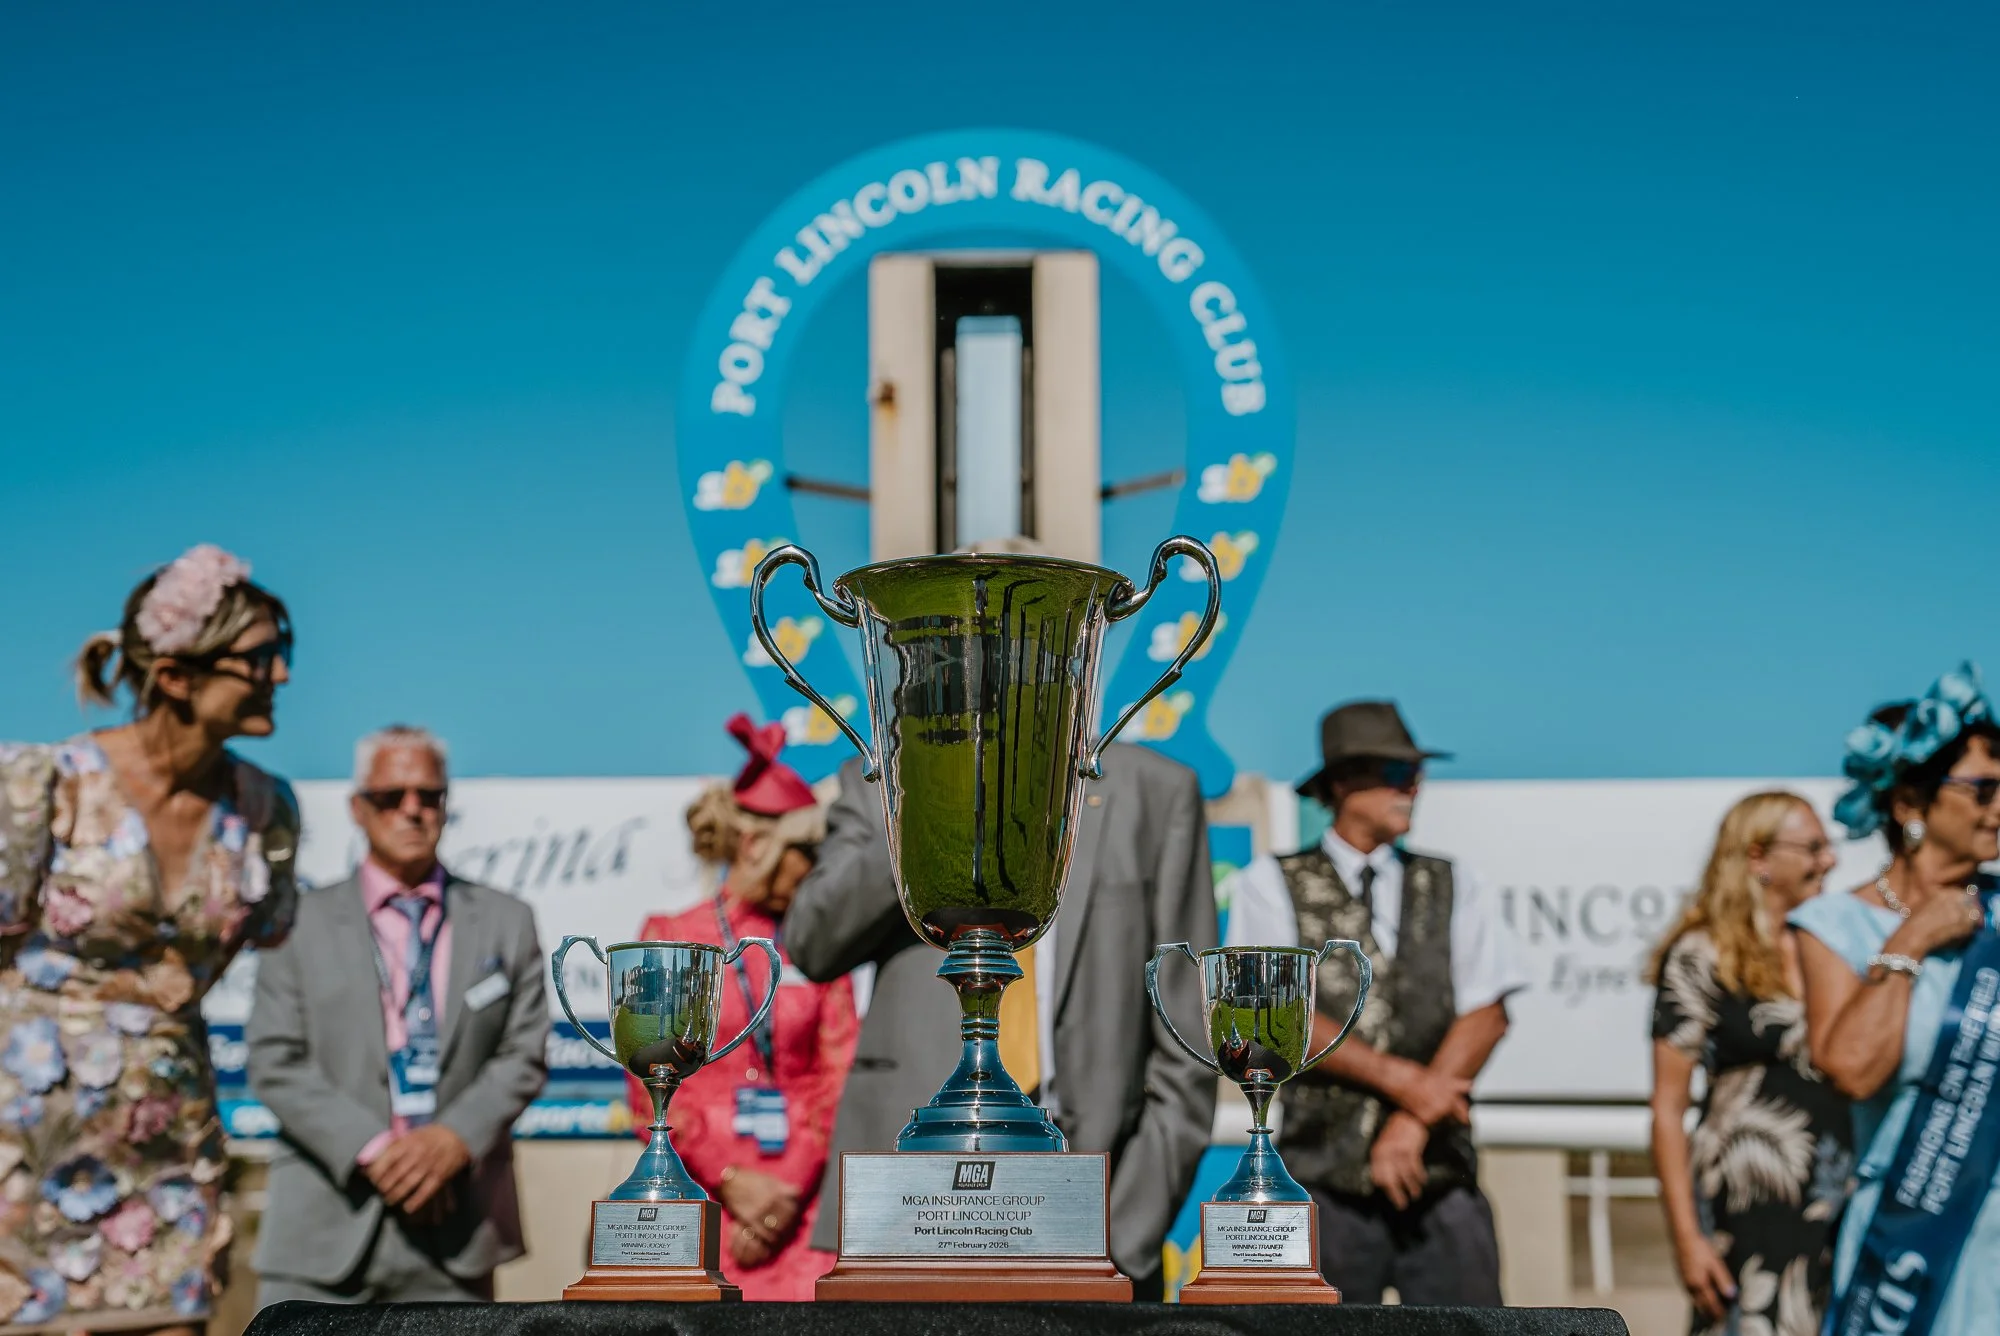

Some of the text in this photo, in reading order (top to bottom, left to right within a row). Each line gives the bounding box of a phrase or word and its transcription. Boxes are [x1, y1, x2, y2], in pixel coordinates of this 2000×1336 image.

[710, 155, 1267, 417] PORT LINCOLN RACING CLUB
[1938, 1062, 1968, 1102] ON
[959, 1164, 989, 1183] MGA
[902, 1195, 1045, 1206] MGA INSURANCE GROUP
[917, 1210, 1032, 1221] PORT LINCOLN CUP
[1249, 1210, 1264, 1220] MGA
[914, 1226, 1033, 1237] Port Lincoln Racing Club
[953, 1241, 987, 1250] February
